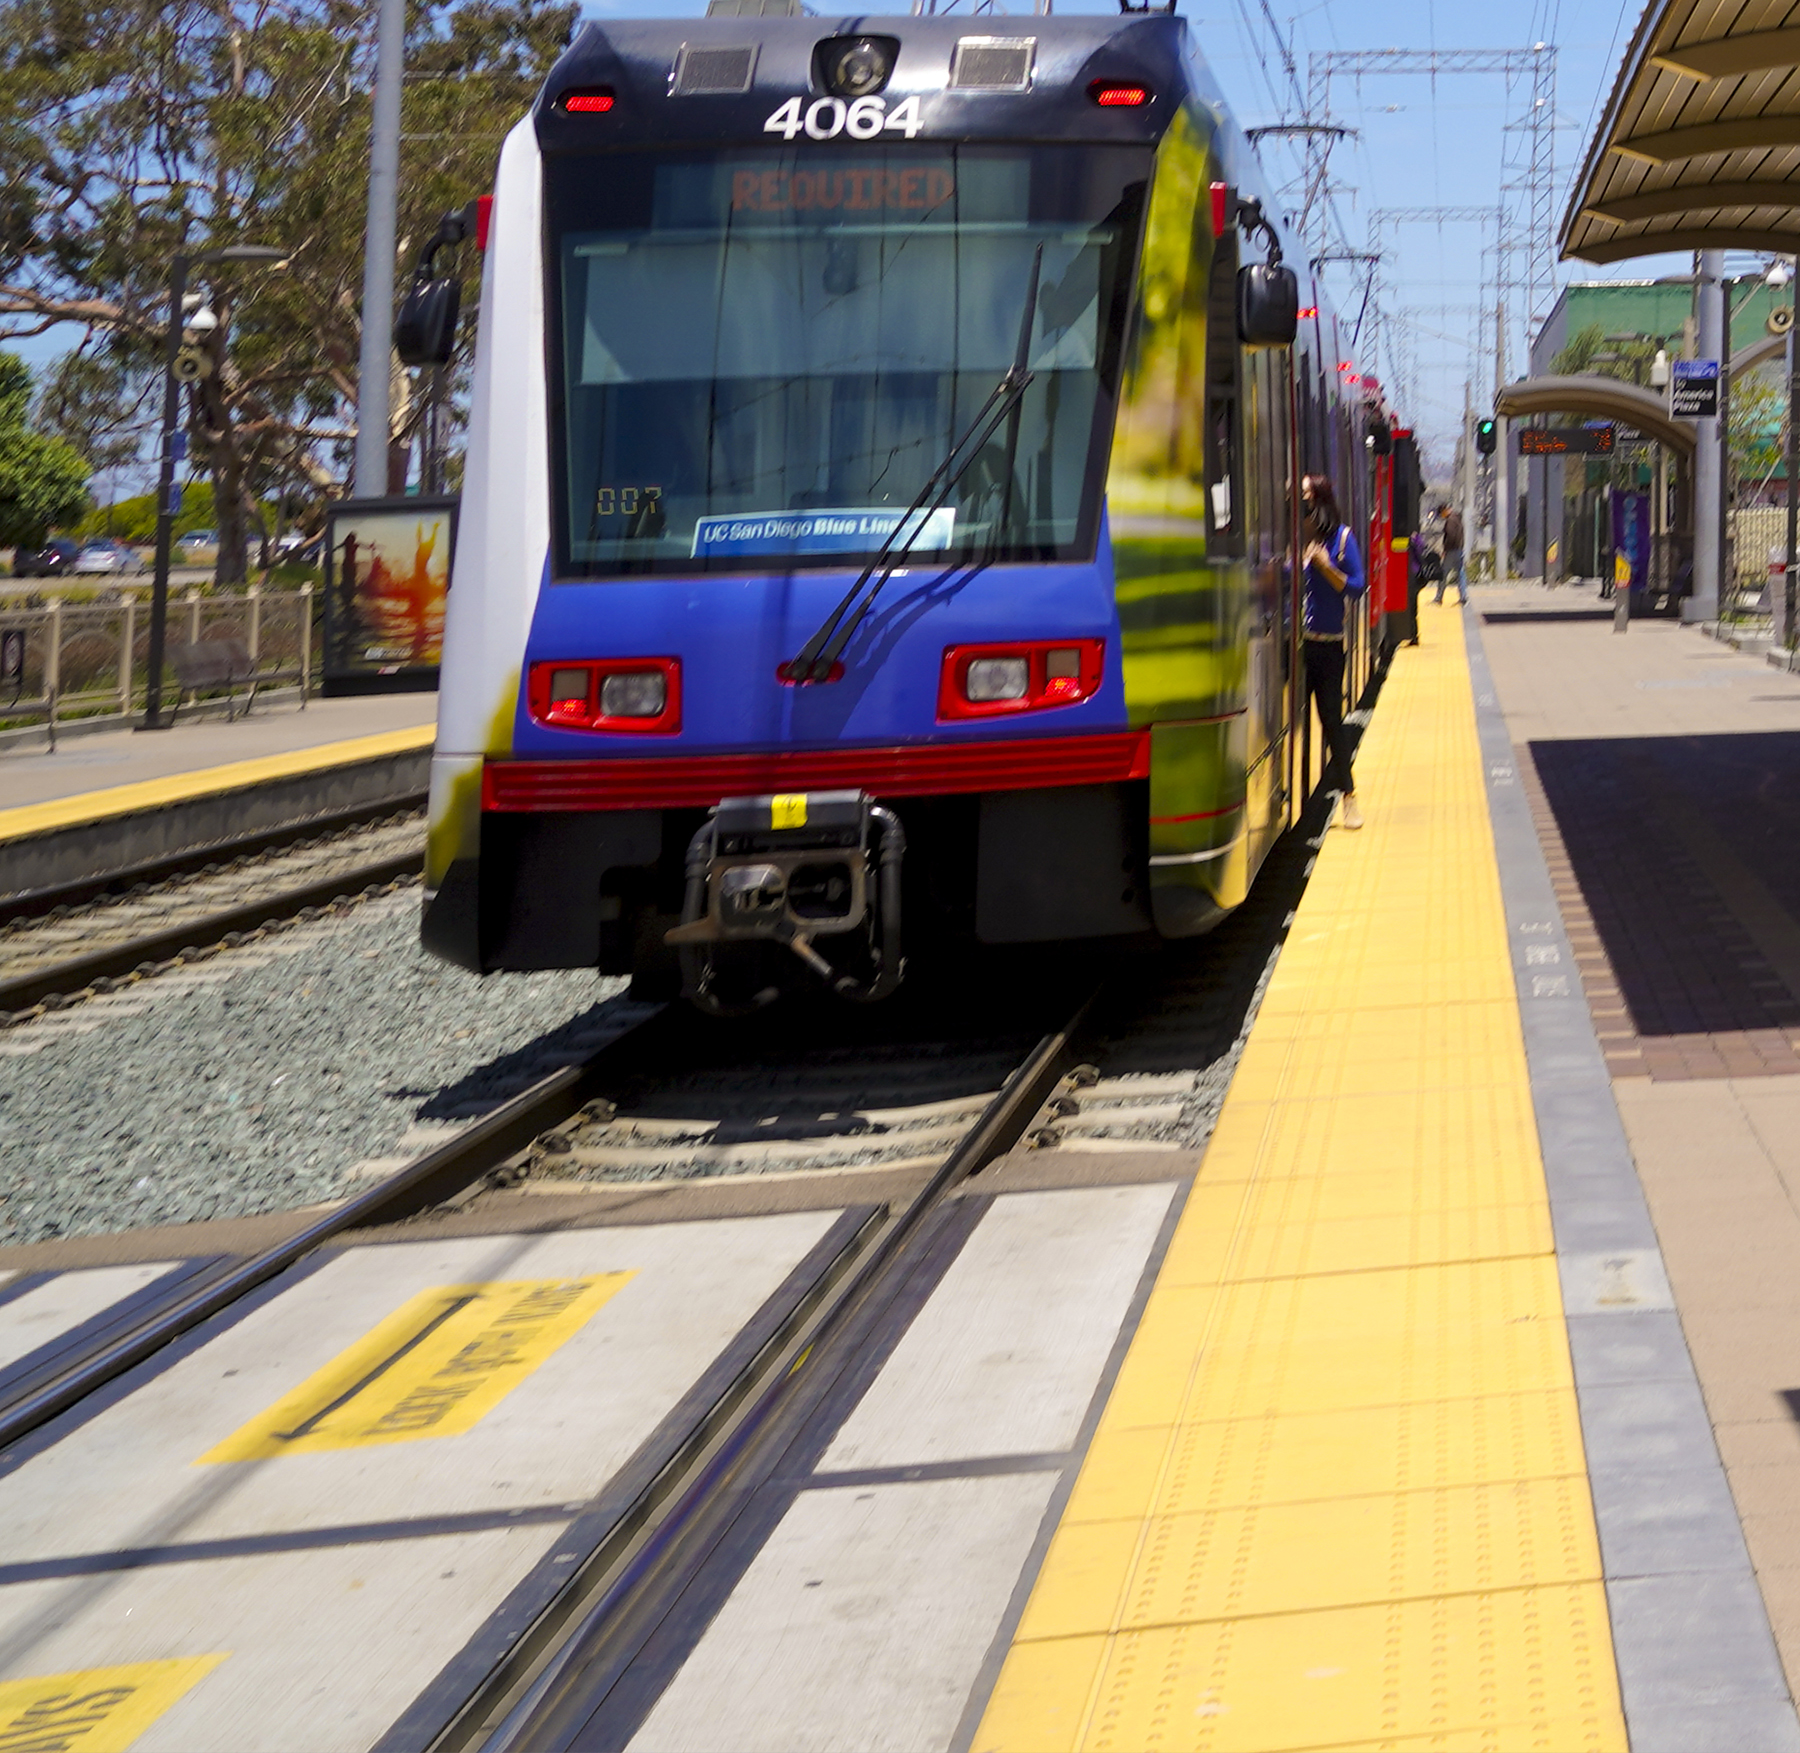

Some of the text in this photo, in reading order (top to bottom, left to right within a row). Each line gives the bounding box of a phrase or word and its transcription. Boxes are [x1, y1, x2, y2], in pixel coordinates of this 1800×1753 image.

[763, 95, 925, 140] 4064
[732, 166, 956, 211] REQUIRED
[703, 523, 730, 544] UC
[729, 521, 764, 543] San
[763, 519, 812, 540] Diego
[813, 517, 858, 536] Blue
